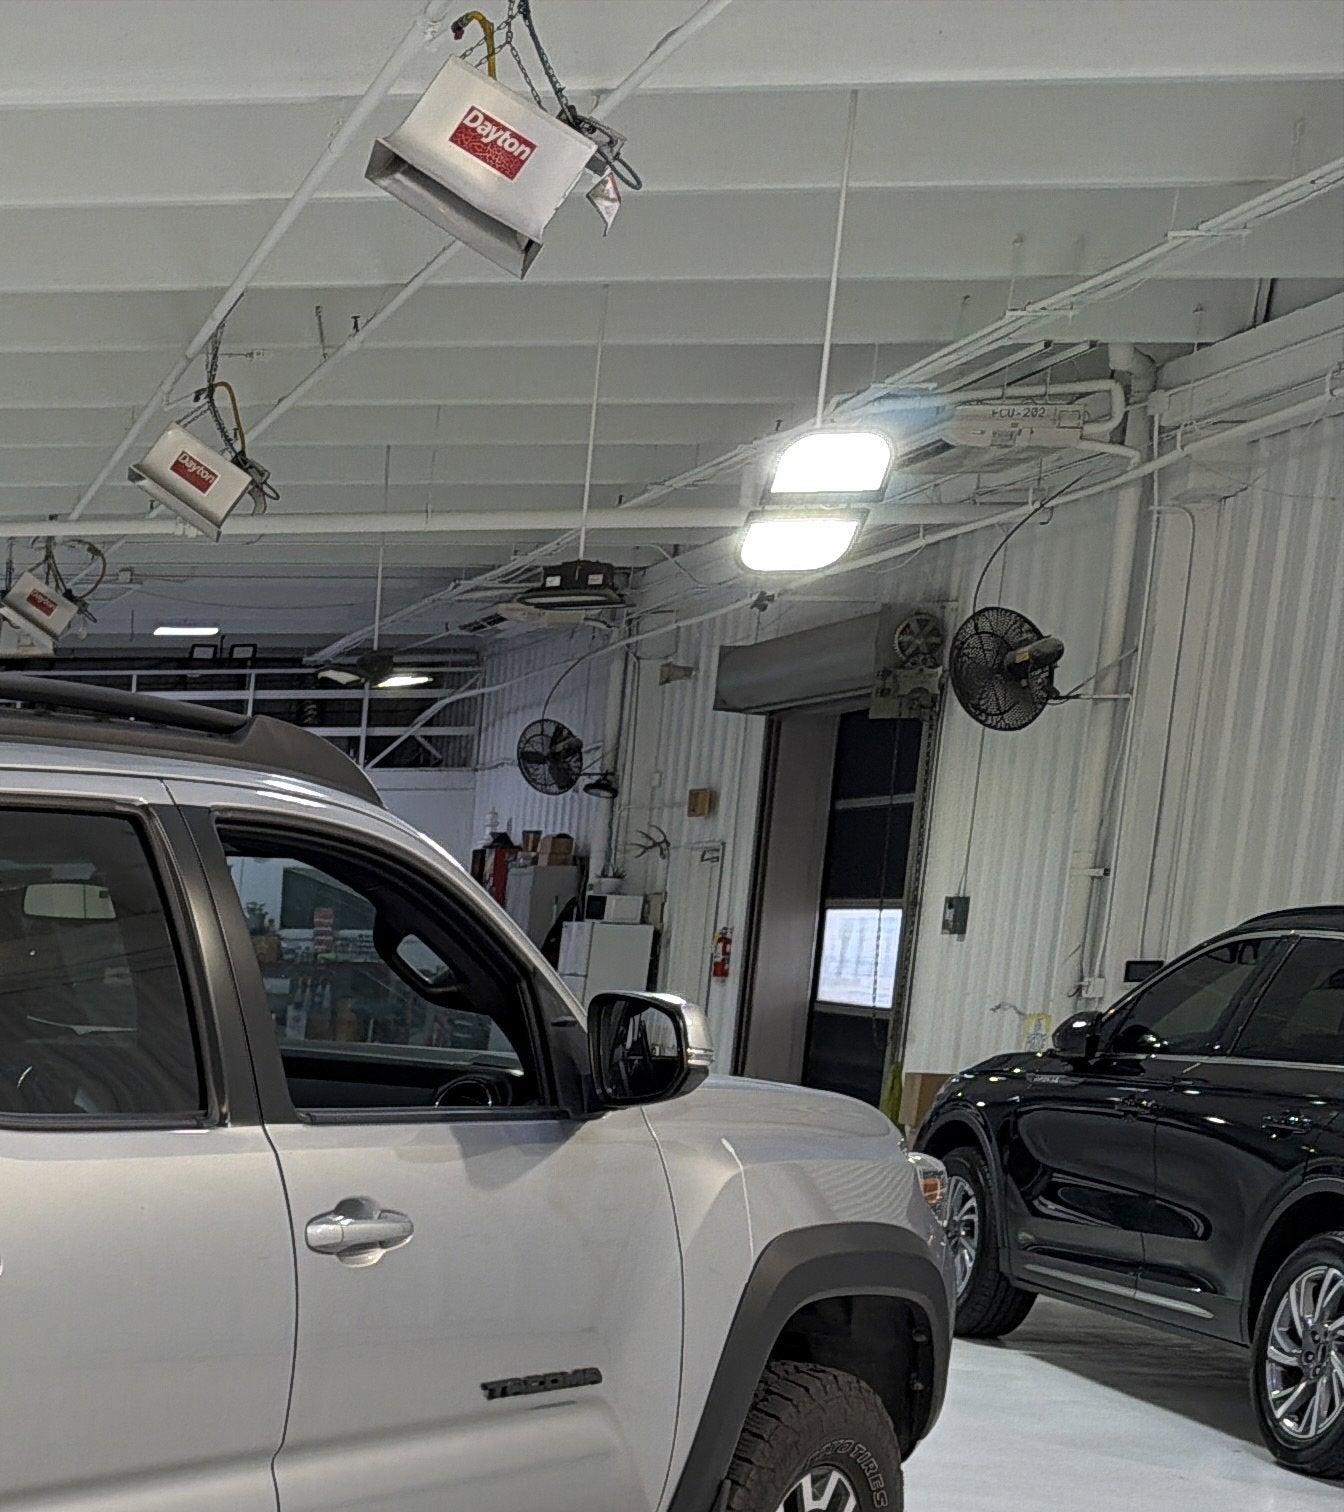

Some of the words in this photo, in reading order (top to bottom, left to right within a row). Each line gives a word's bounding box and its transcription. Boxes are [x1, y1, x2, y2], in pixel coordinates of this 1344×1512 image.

[462, 109, 532, 160] Dayton
[178, 453, 216, 484] Dayton
[849, 1443, 889, 1508] TIRES
